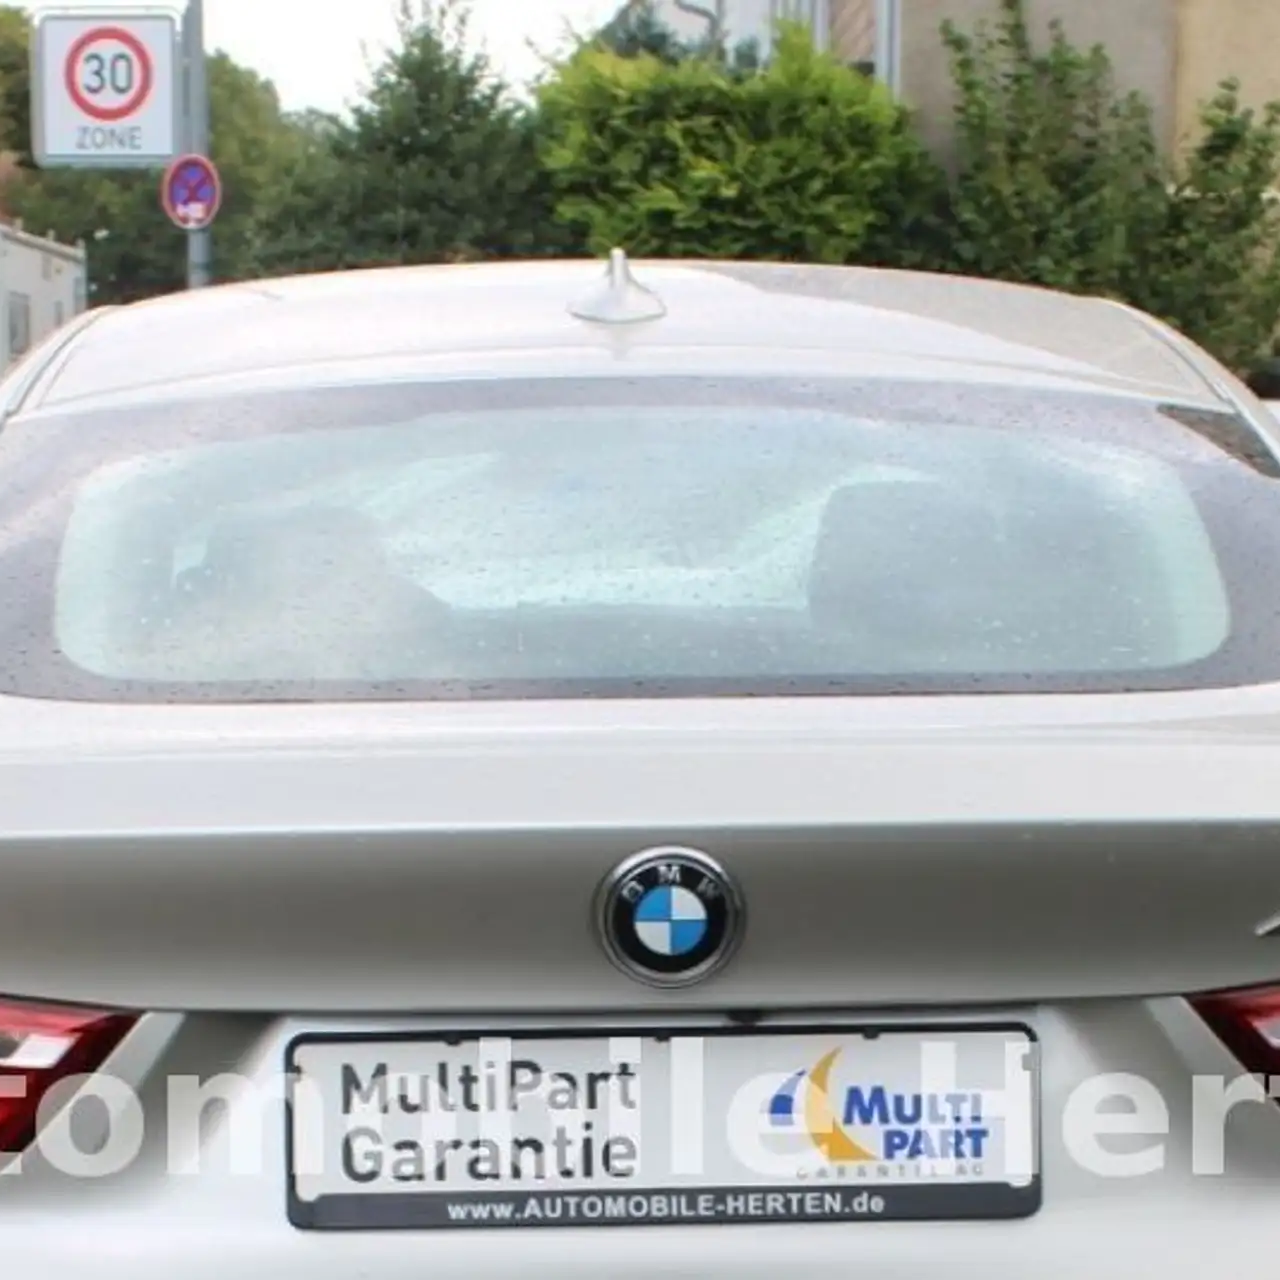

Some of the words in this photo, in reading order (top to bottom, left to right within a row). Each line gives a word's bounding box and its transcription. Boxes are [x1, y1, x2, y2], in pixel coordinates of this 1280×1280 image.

[83, 53, 133, 94] 30
[76, 126, 142, 150] ZONE
[341, 1060, 637, 1114] MultiPart
[341, 1121, 638, 1183] Garantie
[883, 1128, 989, 1161] PART
[448, 1192, 886, 1221] www.AUTOMOBILE-HERTEN.de
